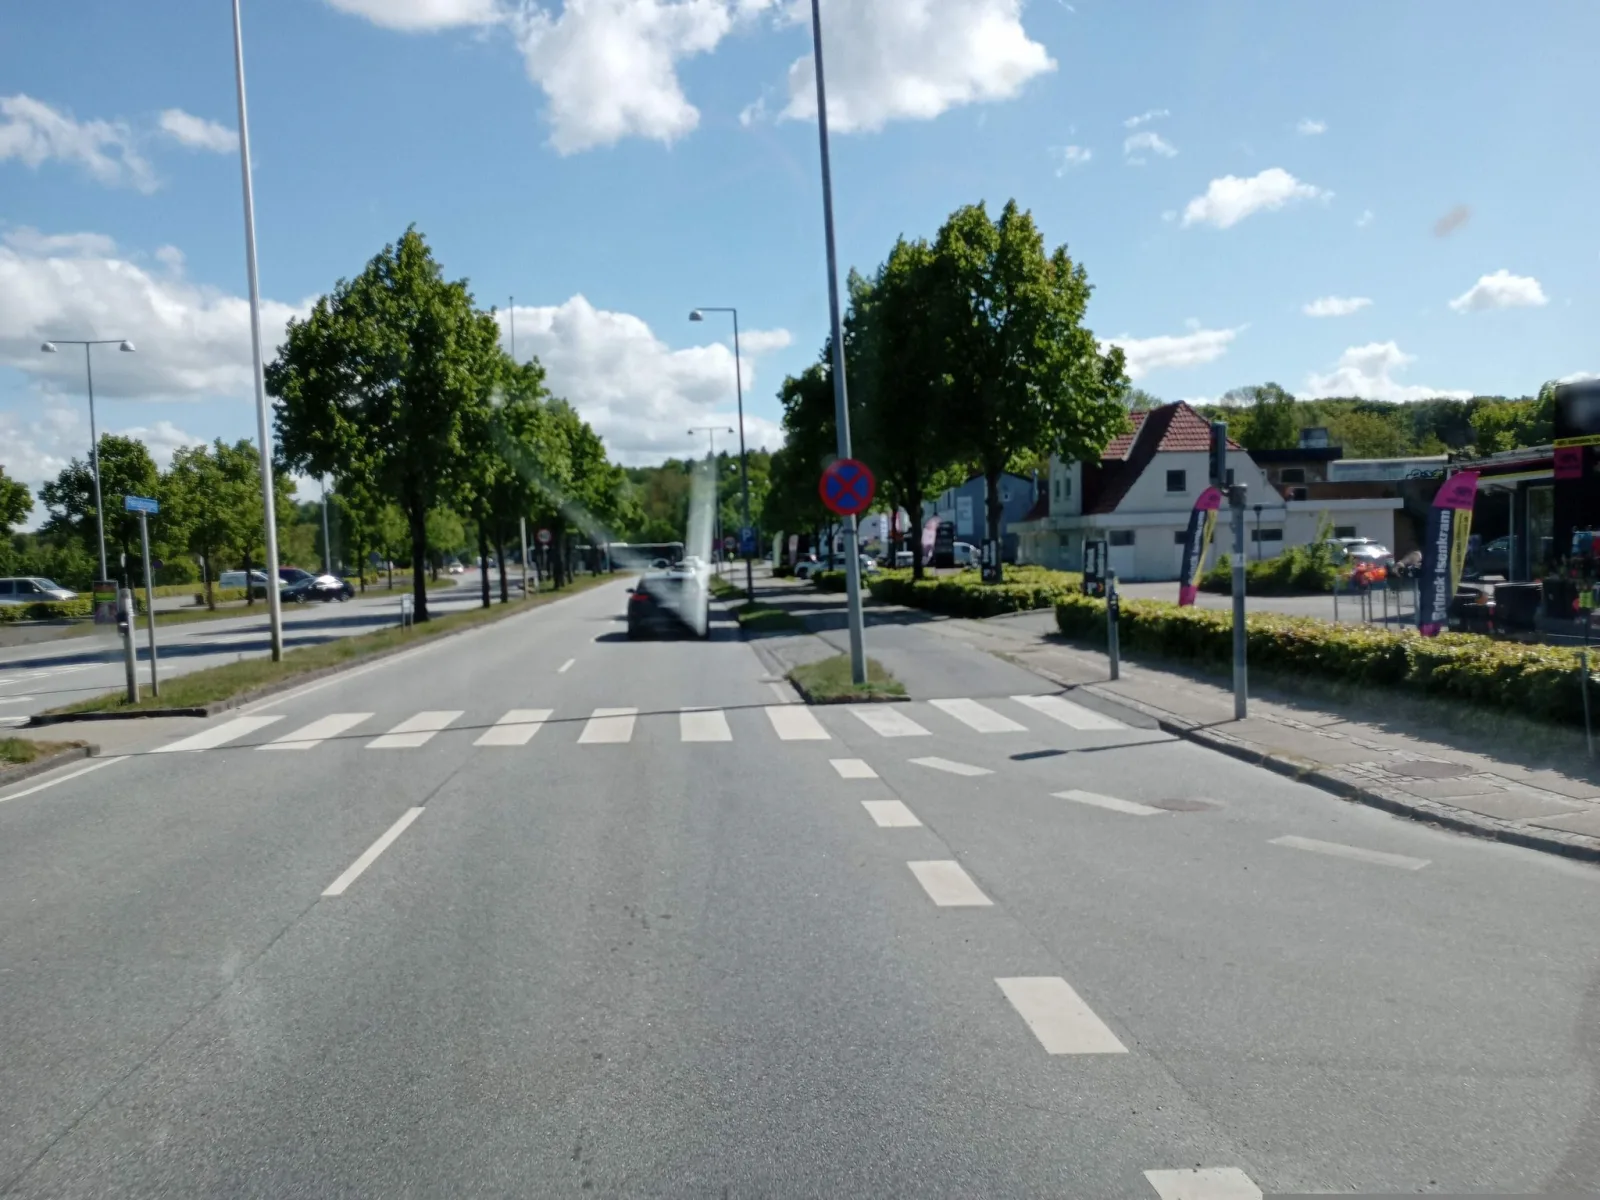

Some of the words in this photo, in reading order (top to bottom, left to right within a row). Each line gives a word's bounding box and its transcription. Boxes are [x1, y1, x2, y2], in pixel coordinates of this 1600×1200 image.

[742, 528, 752, 542] P
[1435, 510, 1451, 572] Isenkram
[1432, 576, 1447, 621] Brinck
